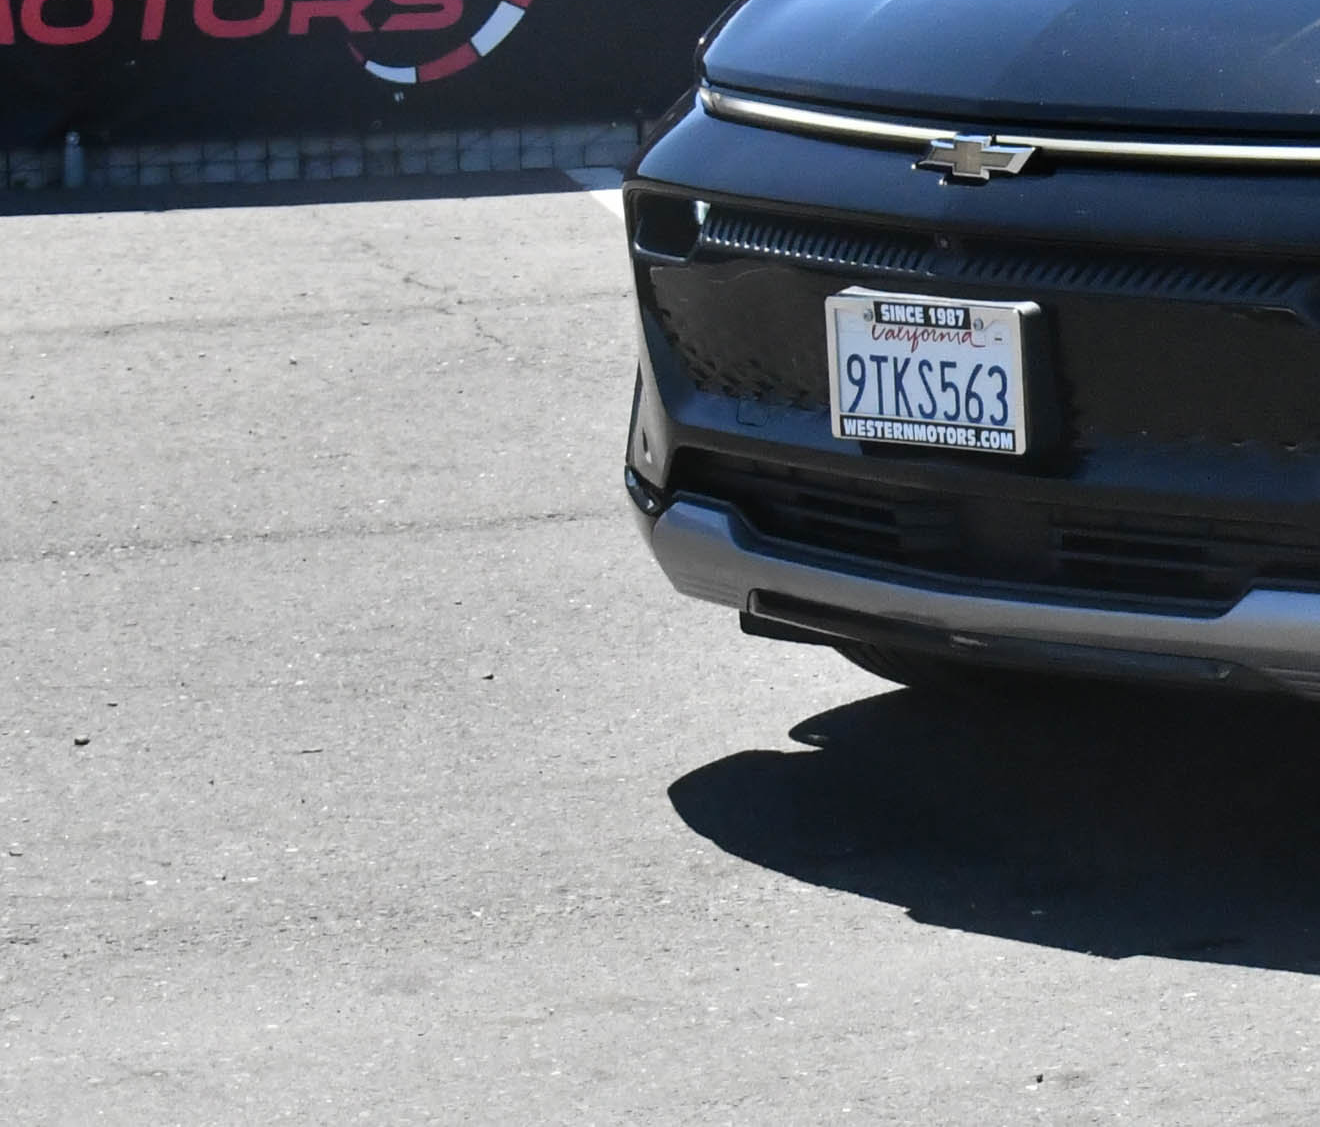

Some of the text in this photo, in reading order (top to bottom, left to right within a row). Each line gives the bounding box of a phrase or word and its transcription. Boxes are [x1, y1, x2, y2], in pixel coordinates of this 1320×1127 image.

[880, 304, 966, 326] SINCE 1987
[846, 353, 1009, 426] 9TKS563
[843, 418, 1014, 450] WESTERNMOTORS.COM
